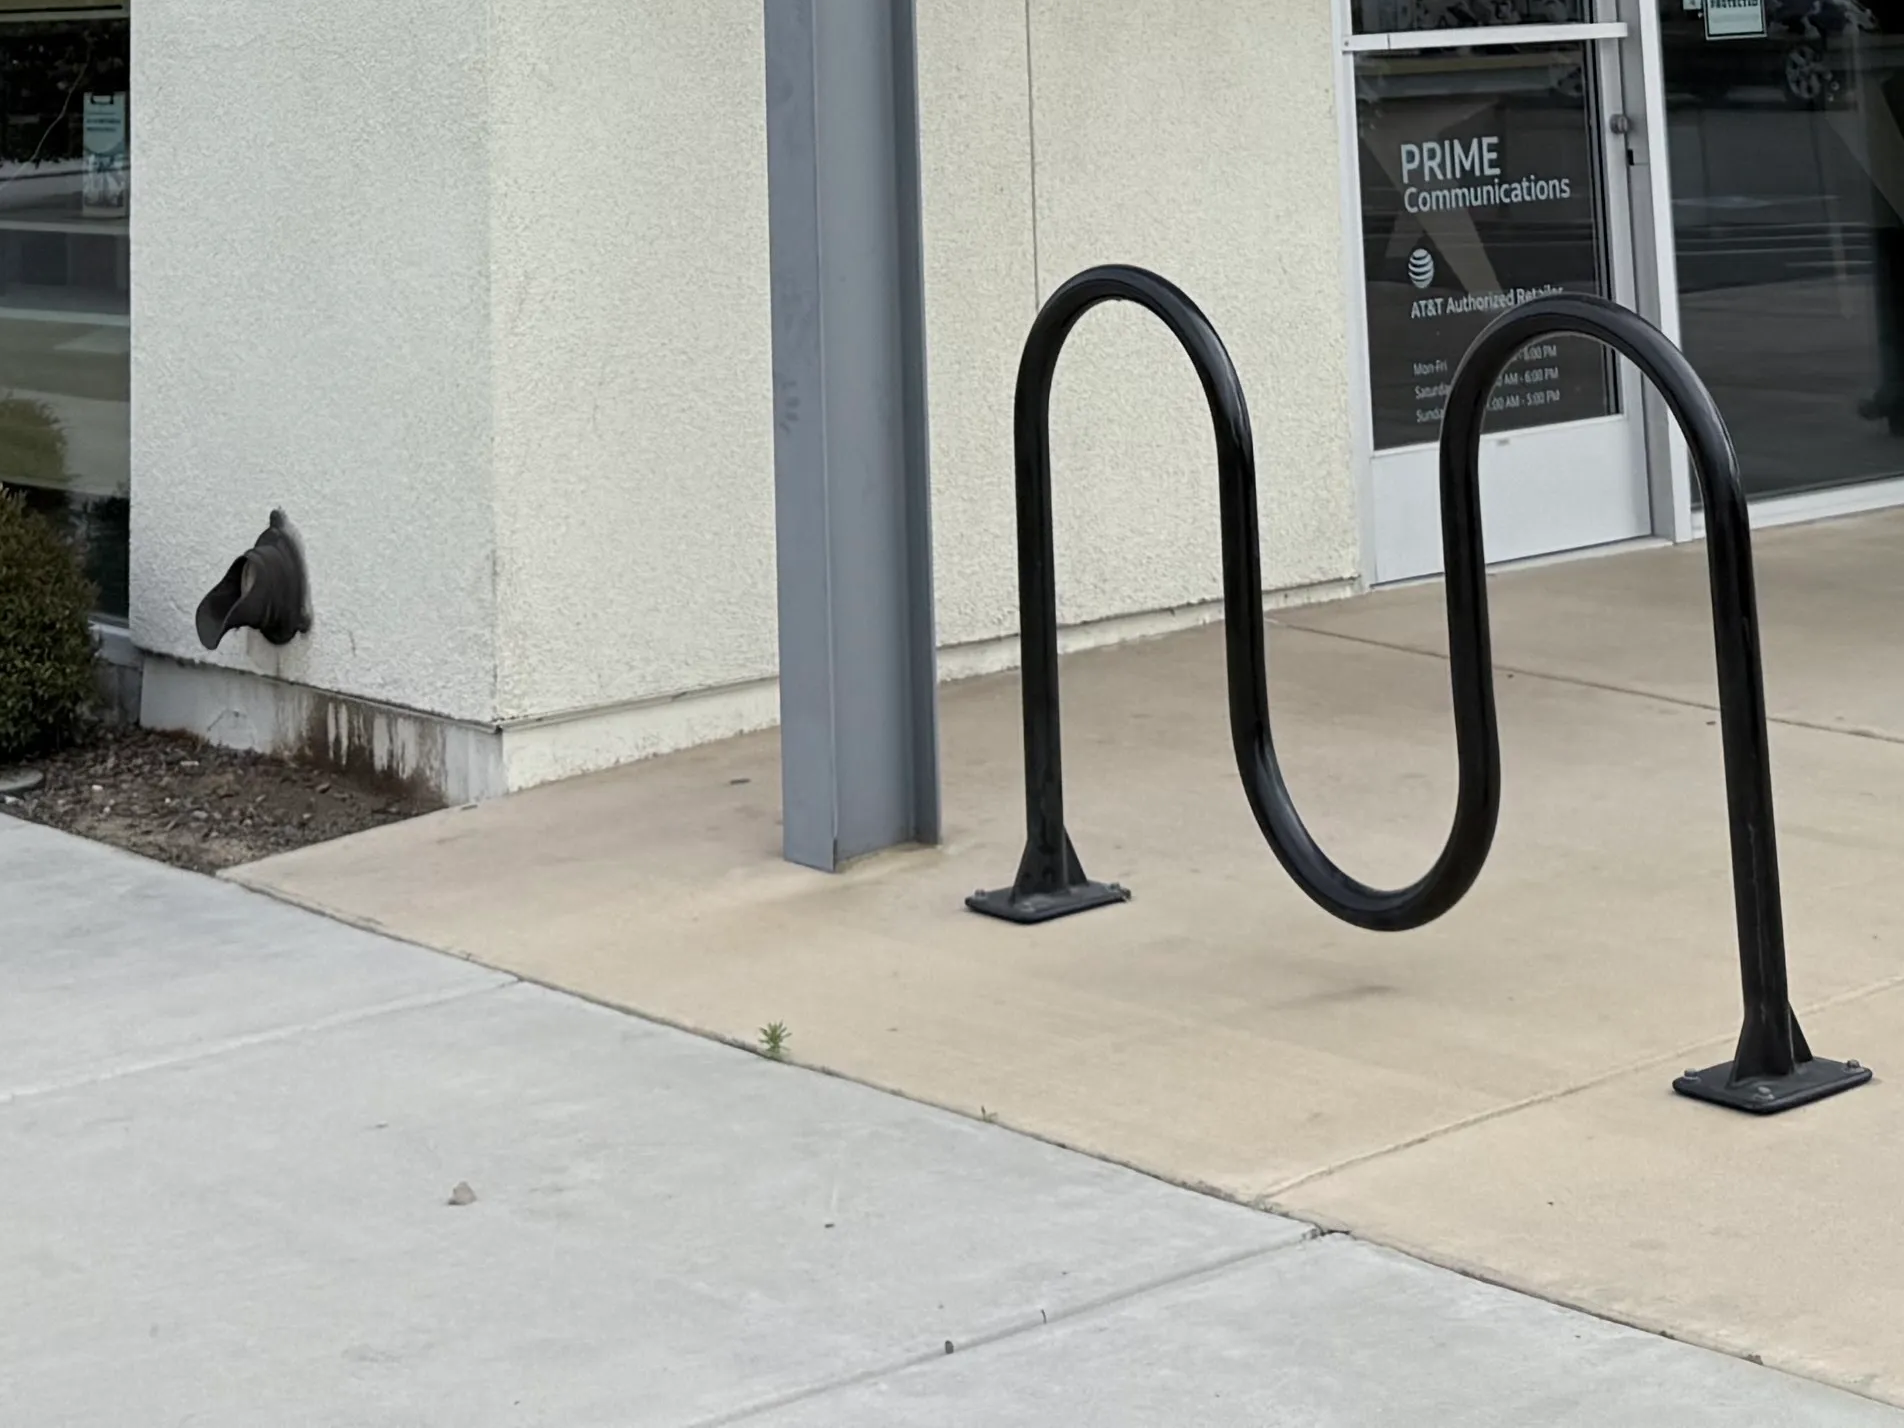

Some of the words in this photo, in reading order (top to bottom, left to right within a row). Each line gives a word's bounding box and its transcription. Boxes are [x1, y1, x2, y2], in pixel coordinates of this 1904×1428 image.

[1400, 135, 1502, 184] PRIME
[1404, 175, 1571, 213] Communications
[1411, 298, 1444, 319] AT&T
[1446, 288, 1515, 314] Authorized
[1413, 359, 1448, 376] Mon-Fri
[1414, 382, 1451, 400] Saturda
[1416, 408, 1444, 423] Sunda
